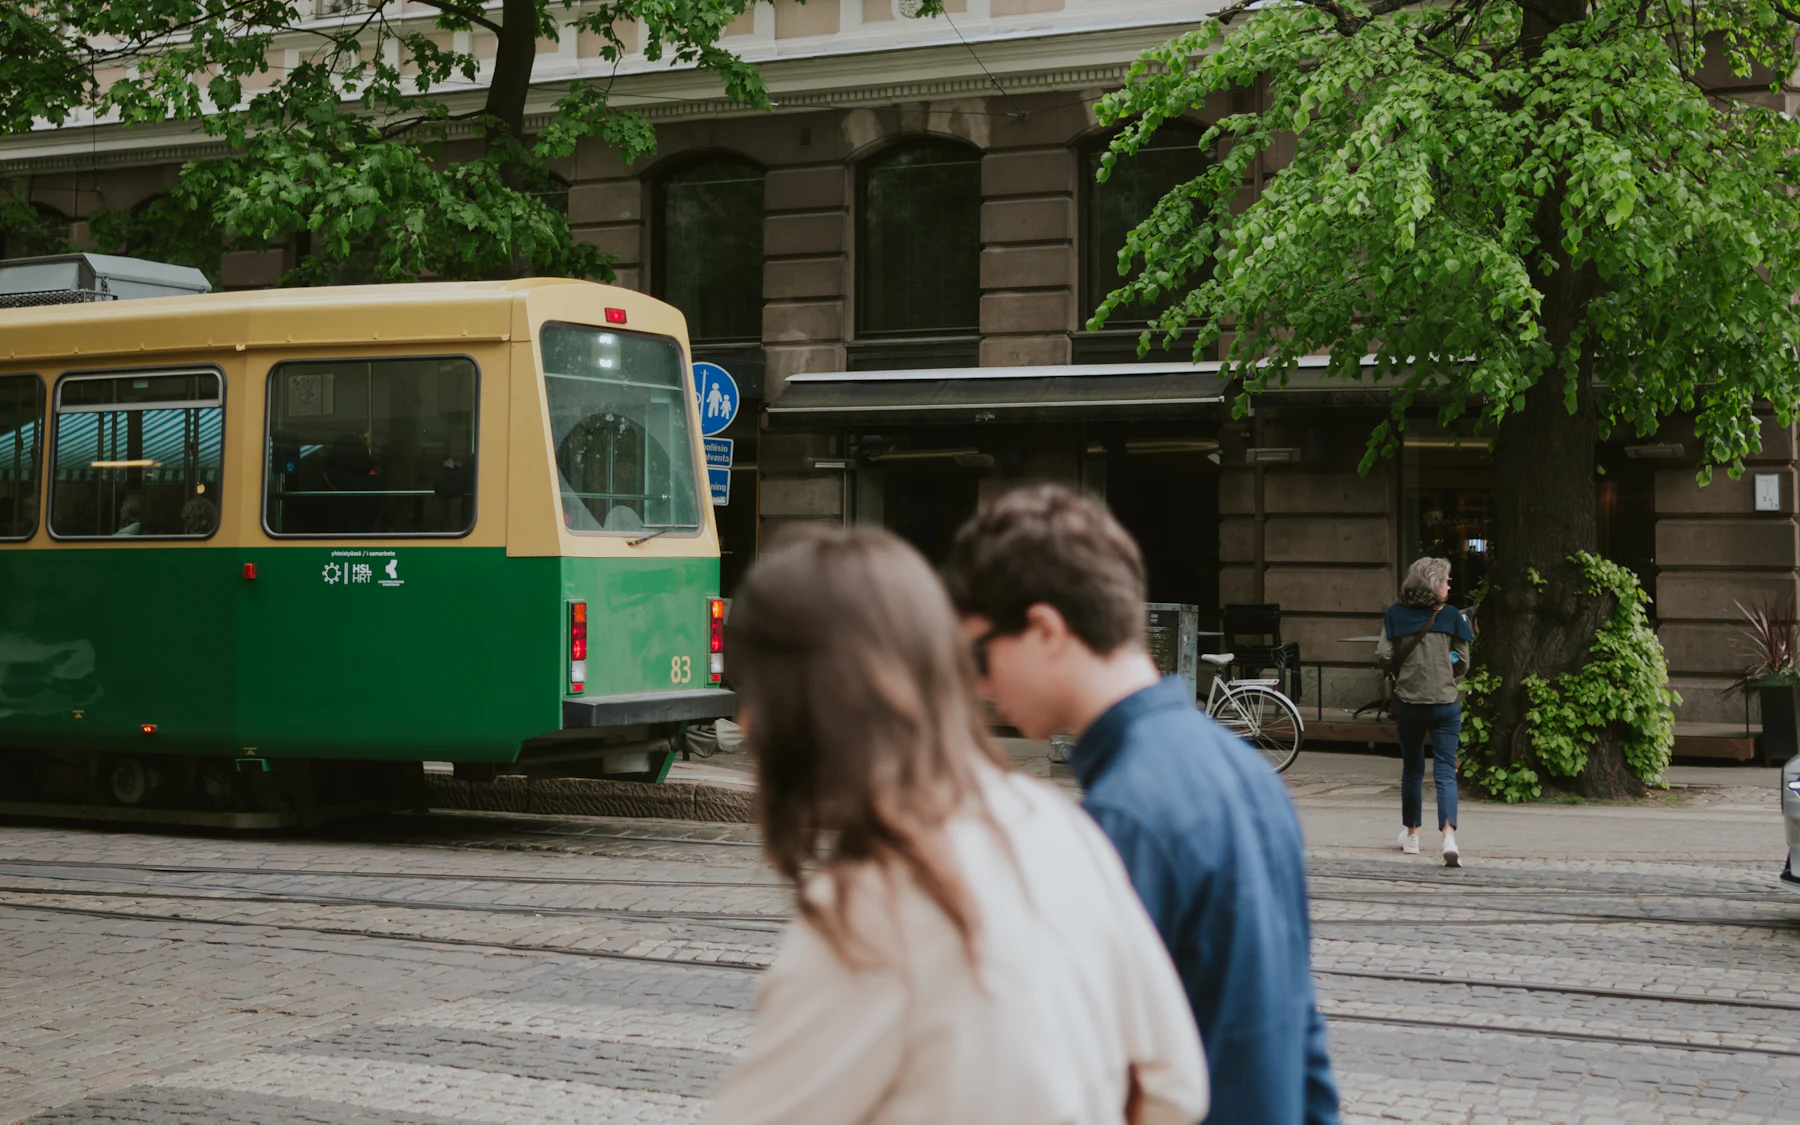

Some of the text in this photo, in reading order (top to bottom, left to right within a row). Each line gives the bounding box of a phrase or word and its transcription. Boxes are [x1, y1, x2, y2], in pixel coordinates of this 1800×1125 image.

[352, 563, 373, 573] HSL
[352, 573, 373, 583] HRT
[670, 655, 691, 684] 83
